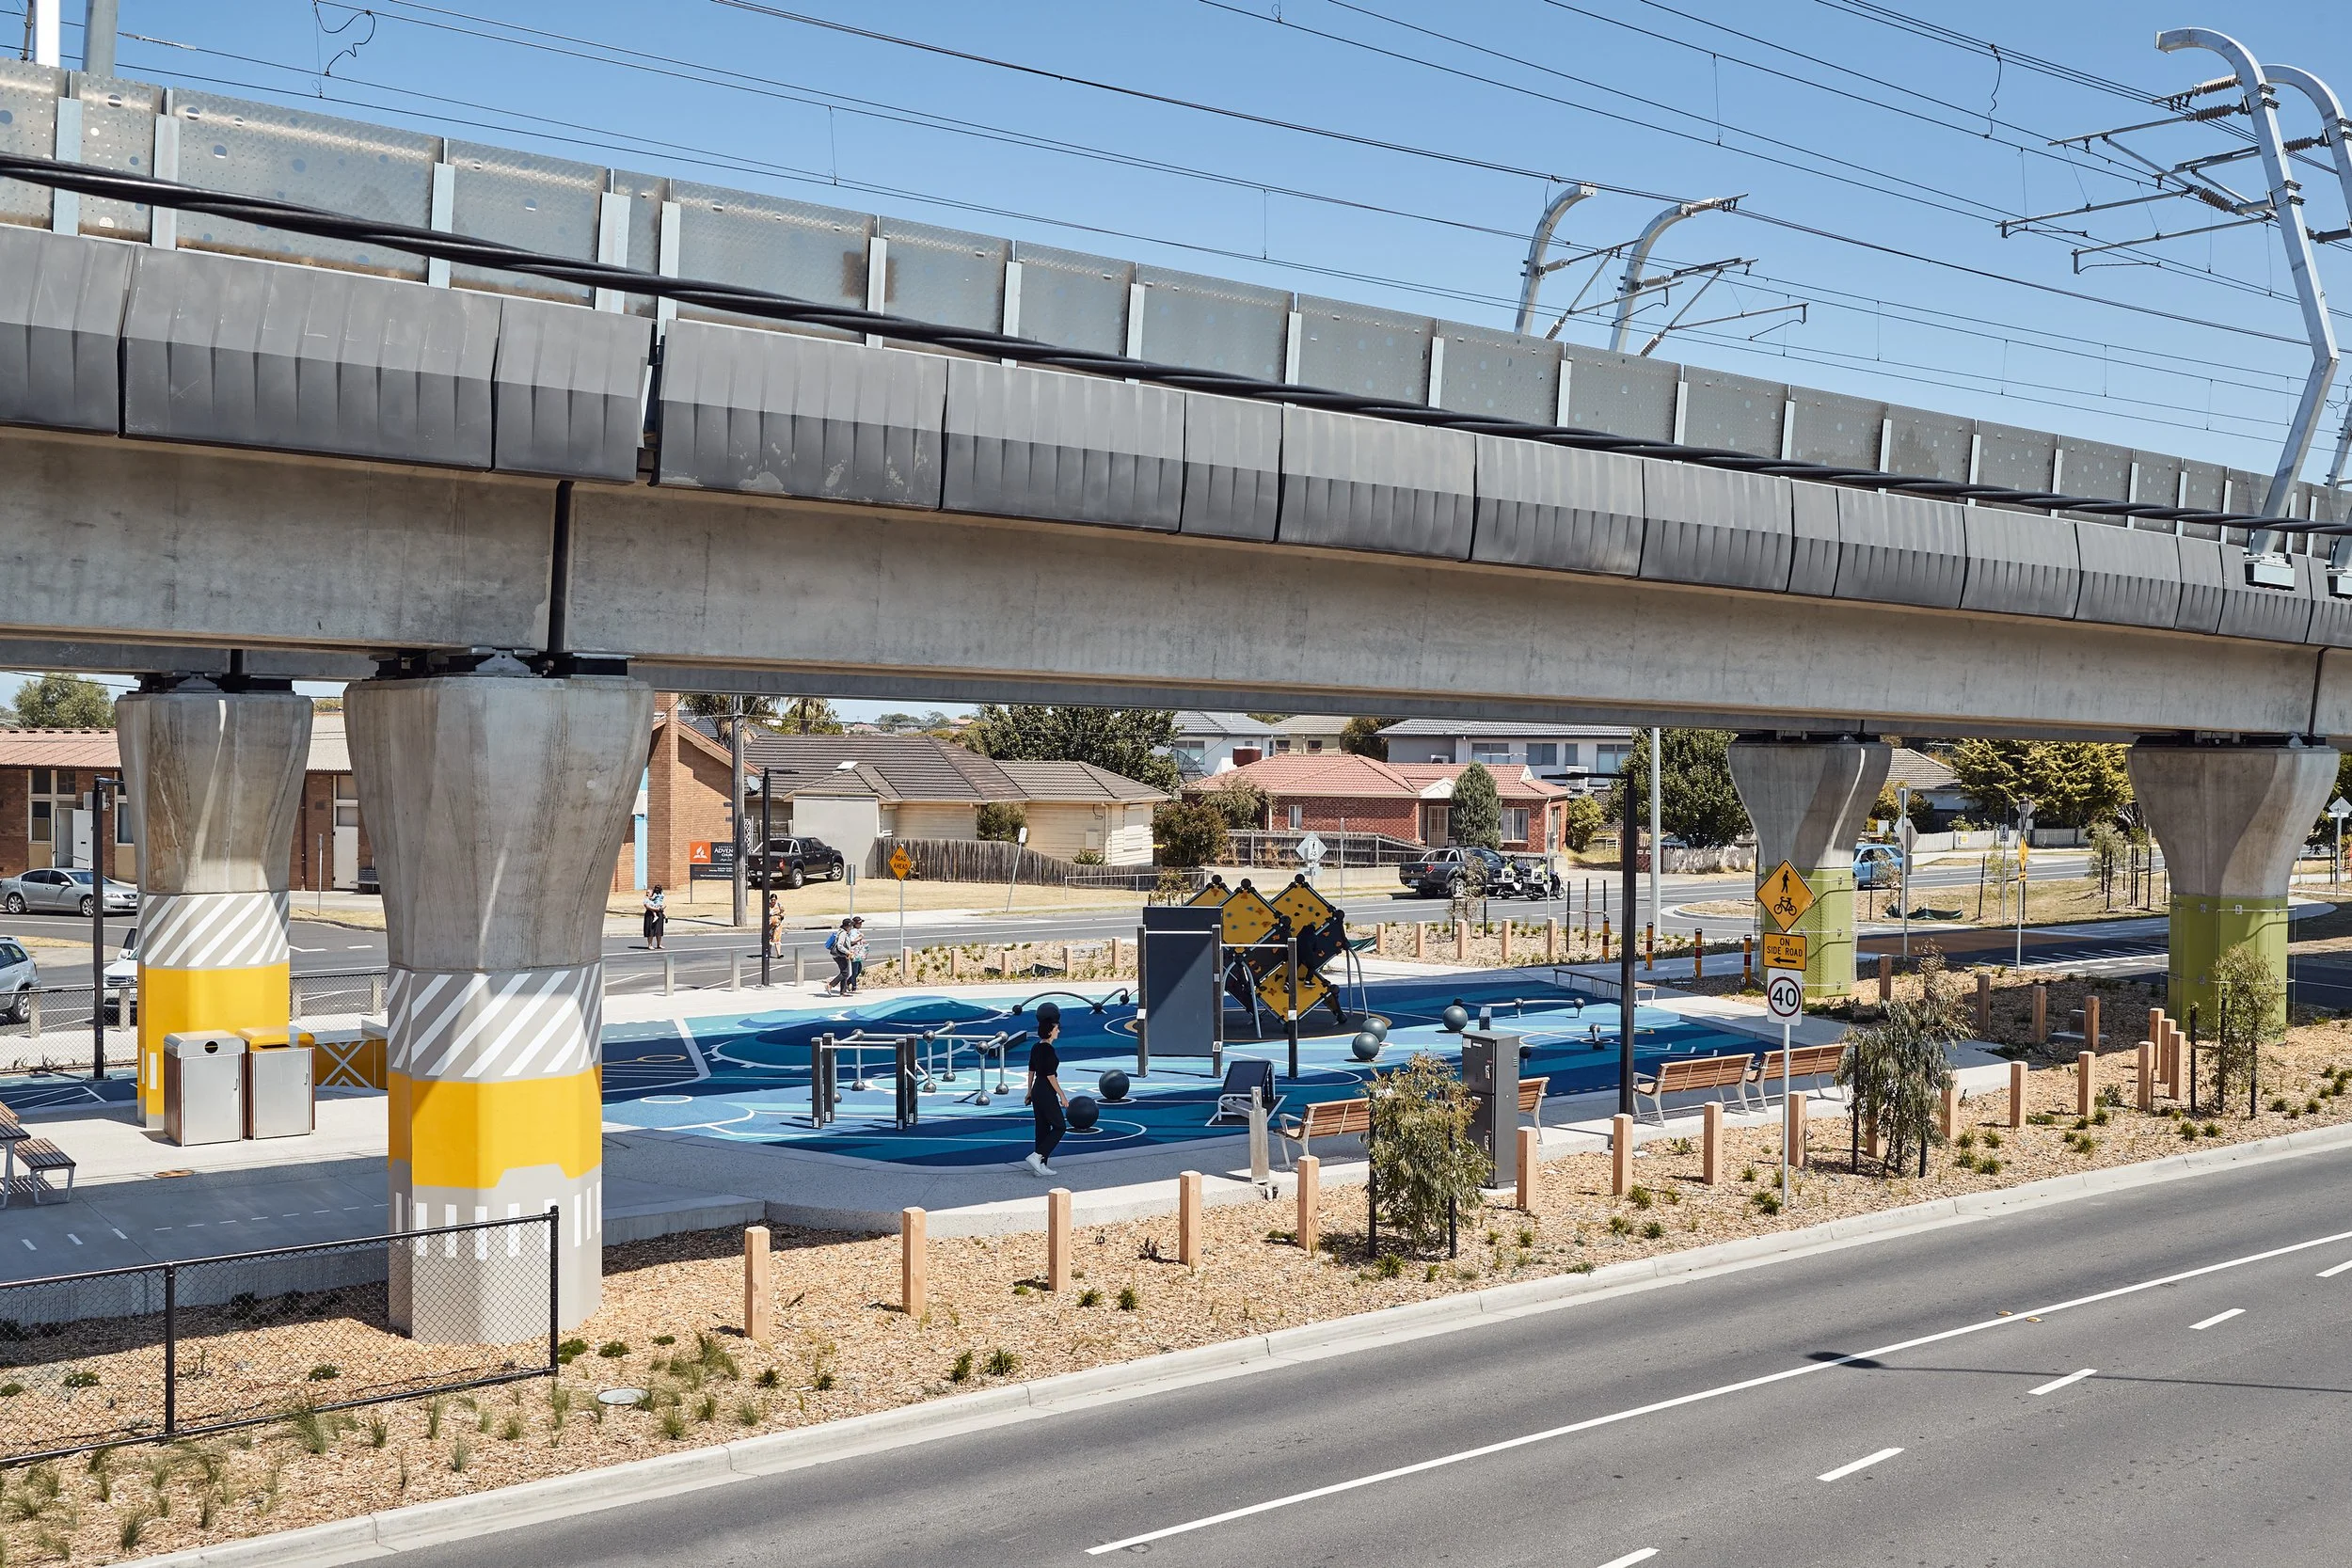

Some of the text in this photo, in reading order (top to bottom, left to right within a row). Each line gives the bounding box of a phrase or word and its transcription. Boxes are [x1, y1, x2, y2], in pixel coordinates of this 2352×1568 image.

[1779, 938, 1790, 946] ON
[1767, 945, 1803, 958] SIDE ROAD
[1772, 987, 1797, 1007] 40
